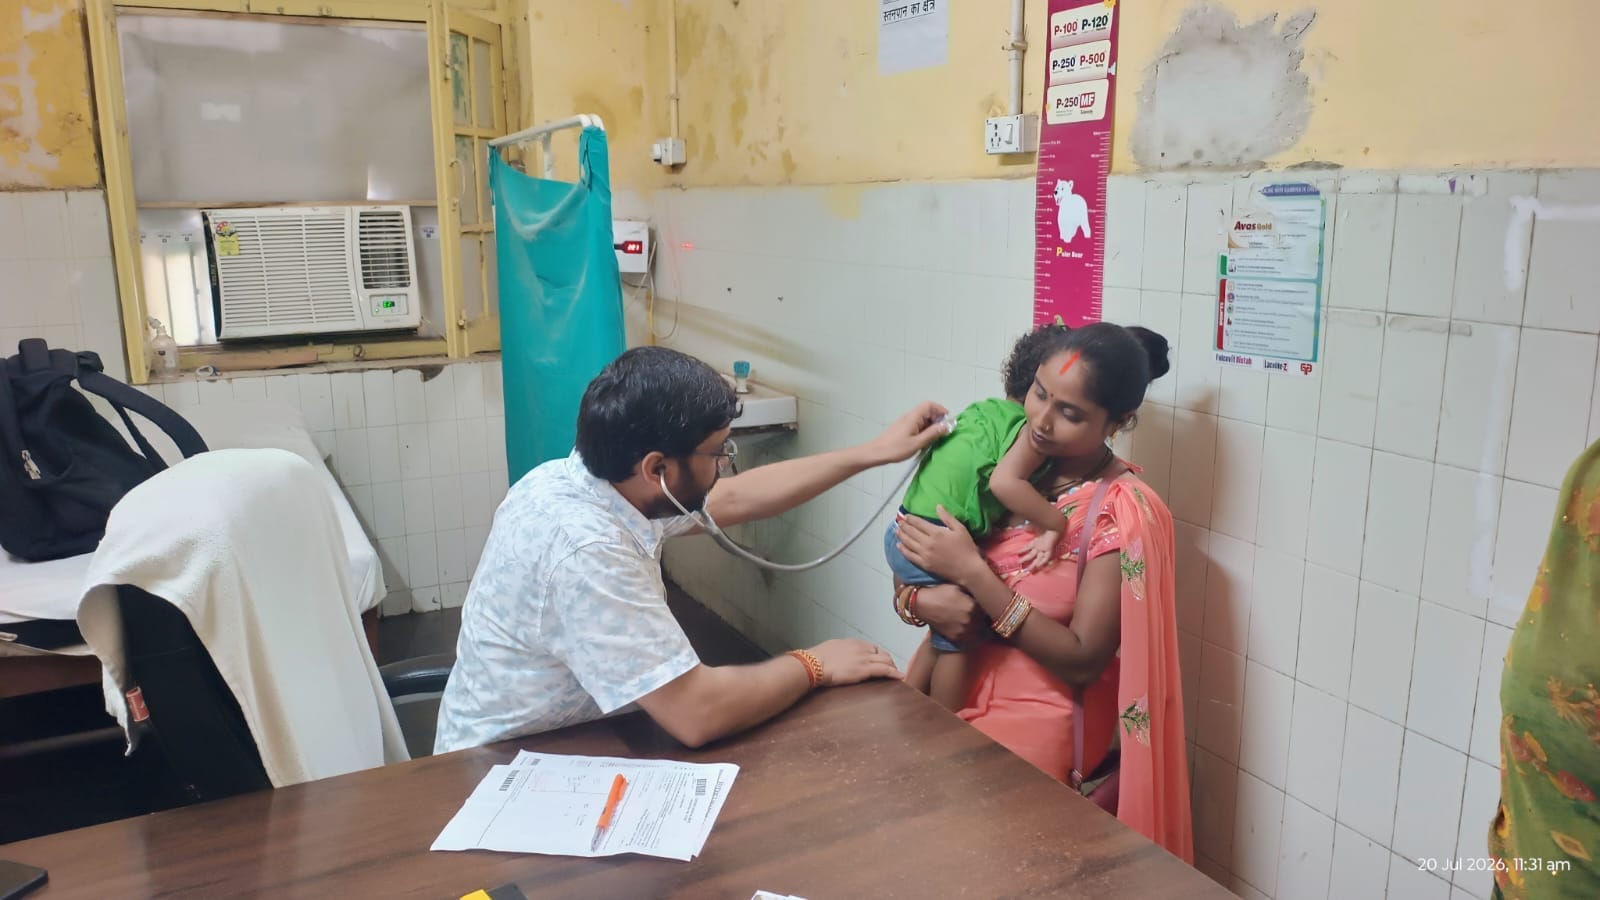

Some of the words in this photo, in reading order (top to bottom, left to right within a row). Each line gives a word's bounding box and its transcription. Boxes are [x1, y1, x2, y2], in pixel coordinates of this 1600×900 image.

[910, 3, 920, 15] का
[1054, 21, 1078, 36] P-100
[1081, 15, 1109, 30] P-120
[1052, 57, 1076, 70] P-250
[1080, 52, 1105, 66] P-500
[1056, 97, 1079, 109] P-250
[1081, 93, 1095, 107] MF
[1234, 221, 1256, 230] Avas
